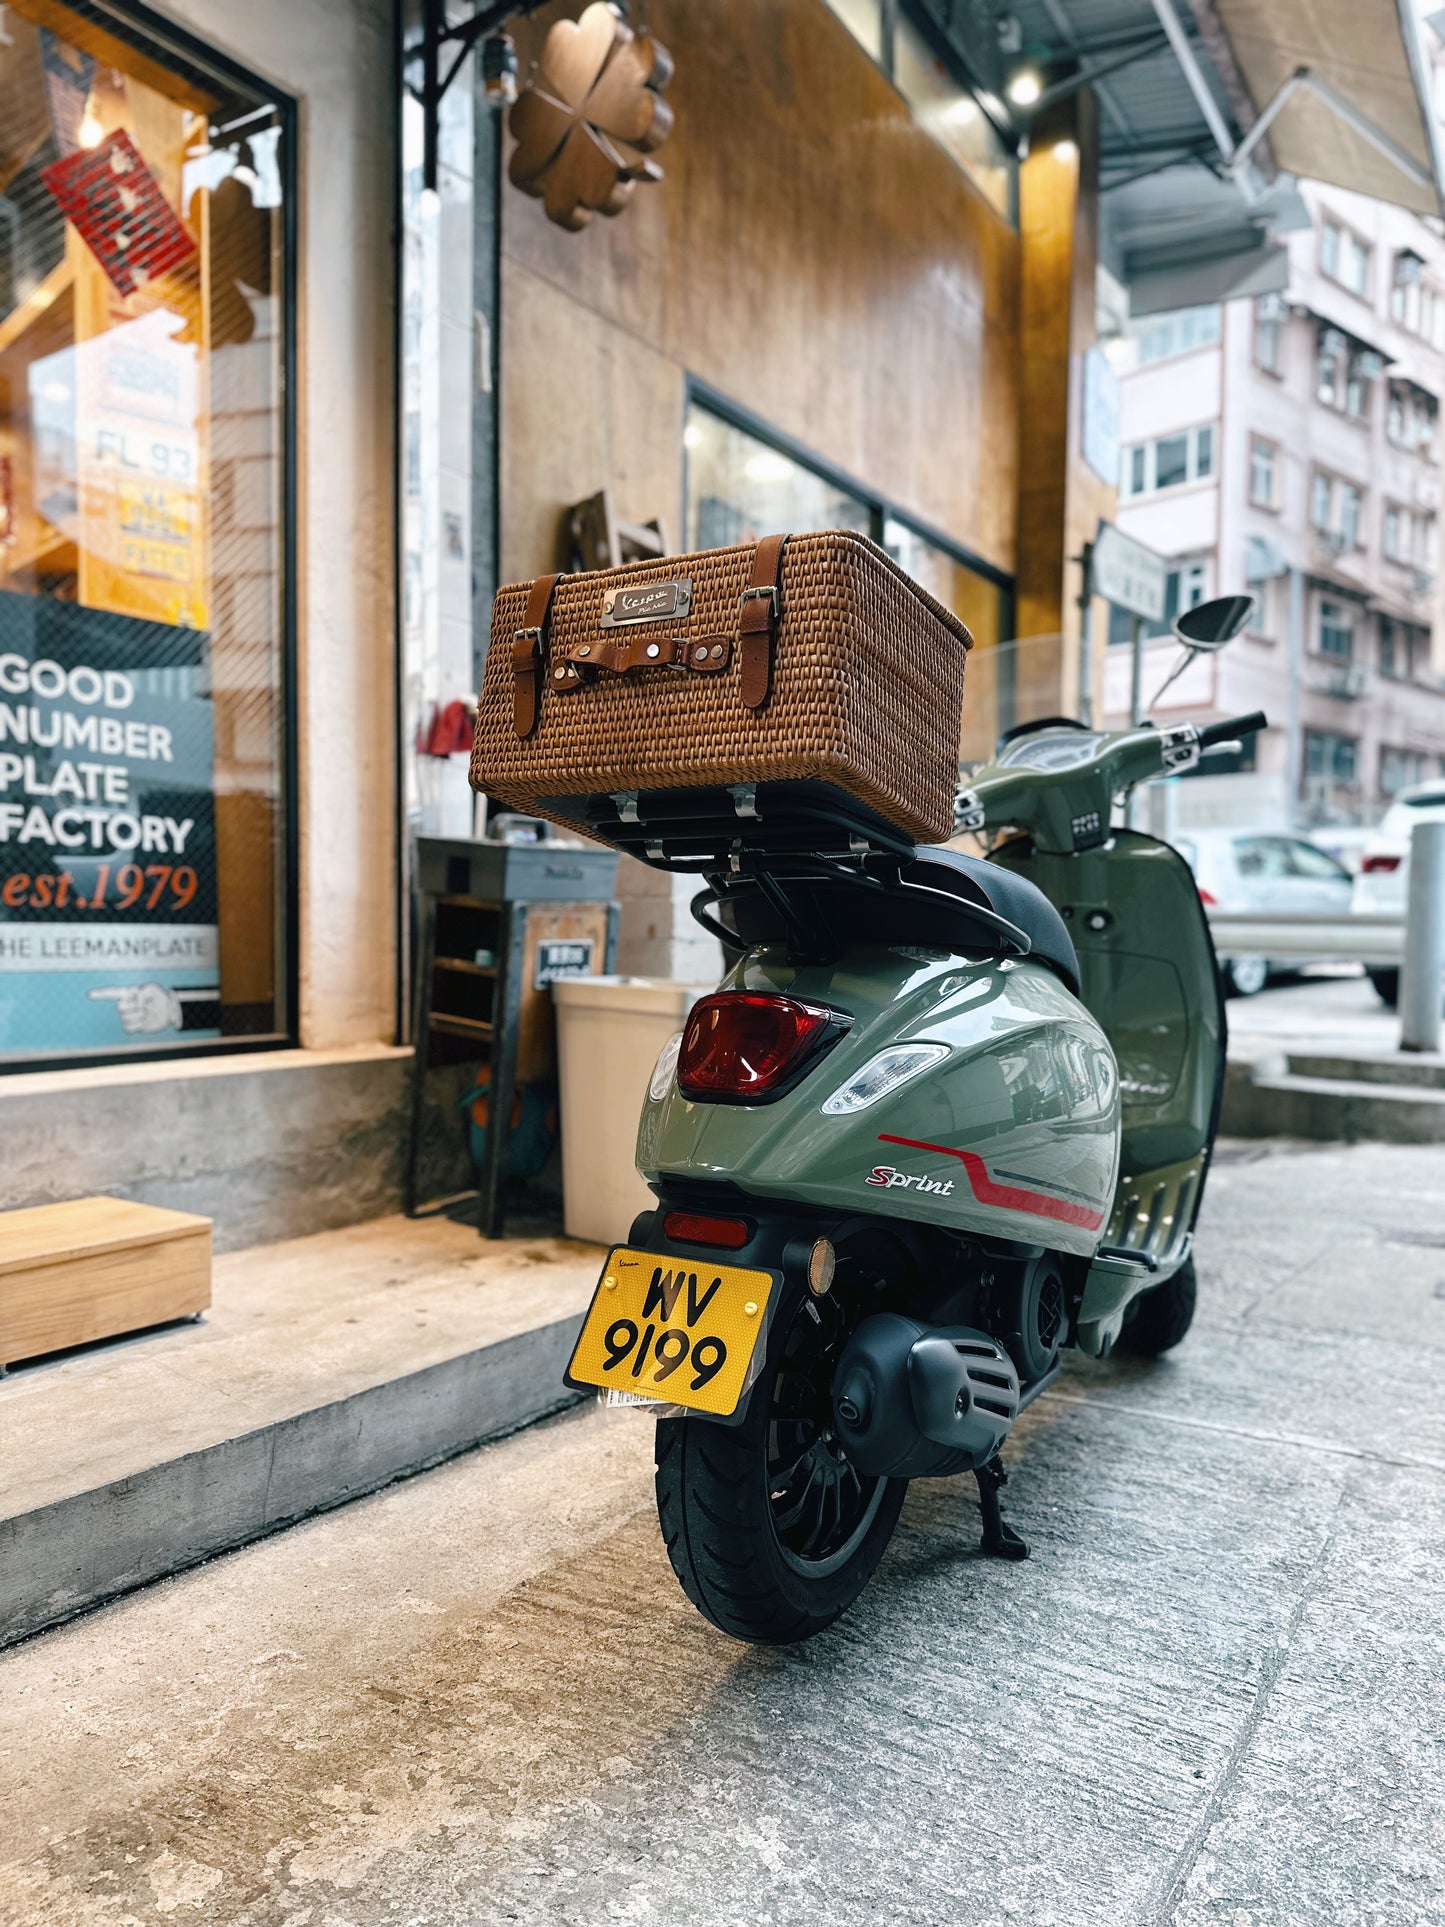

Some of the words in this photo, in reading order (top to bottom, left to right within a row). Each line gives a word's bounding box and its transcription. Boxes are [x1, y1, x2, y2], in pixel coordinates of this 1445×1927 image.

[0, 653, 134, 709] GOOD
[0, 702, 174, 762] NUMBER
[0, 752, 129, 803] PLATE
[0, 803, 194, 854] FACTORY
[2, 863, 198, 910] est.1979
[40, 936, 208, 959] LEEMANPLATE
[864, 1165, 955, 1196] Sprint
[641, 1267, 722, 1328] WV
[602, 1318, 728, 1391] 9199
